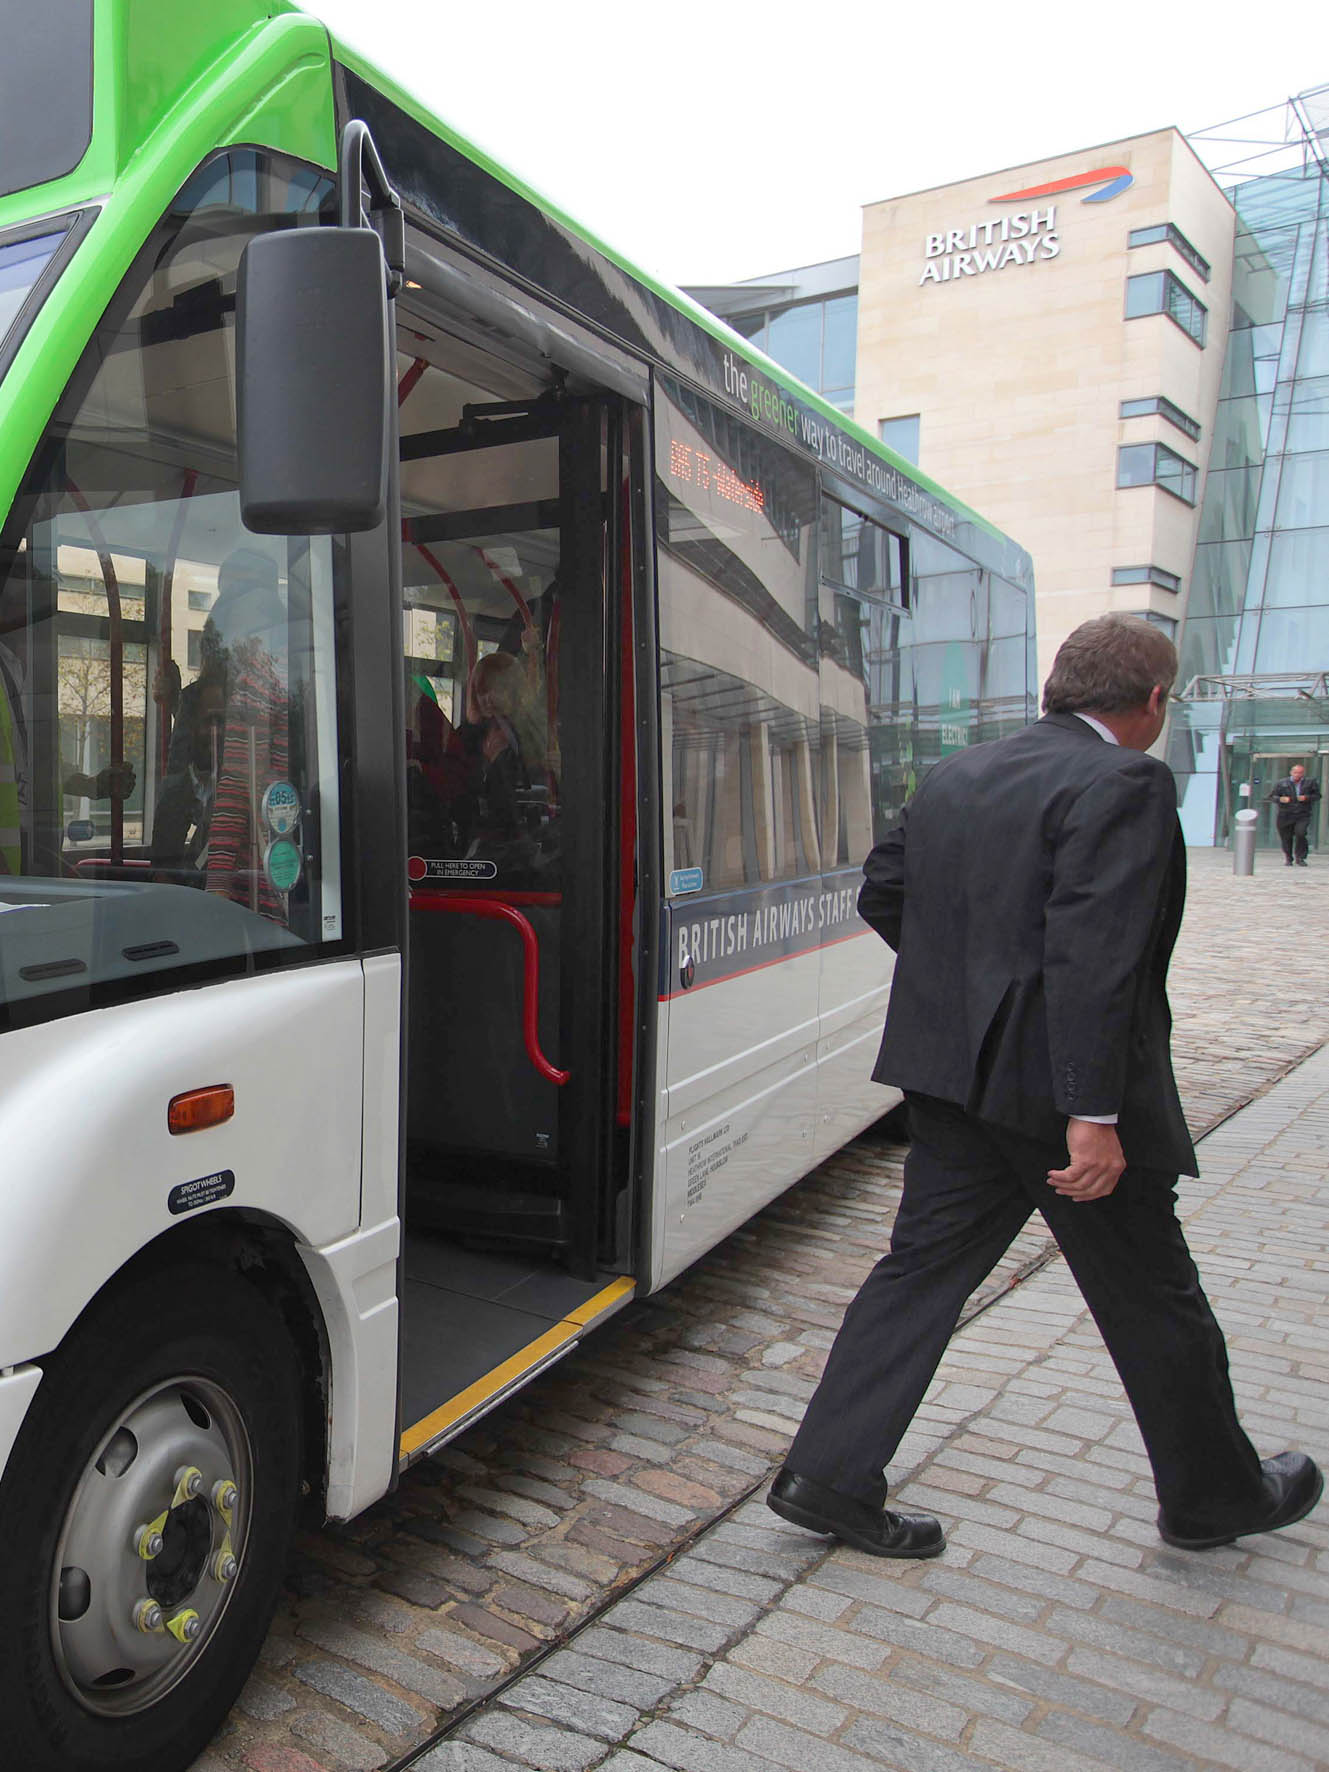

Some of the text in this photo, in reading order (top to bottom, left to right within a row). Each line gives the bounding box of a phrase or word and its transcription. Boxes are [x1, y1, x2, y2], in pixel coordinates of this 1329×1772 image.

[925, 205, 1057, 259] BRITISH
[919, 232, 1061, 287] AIRWAYS
[723, 353, 748, 403] the
[750, 380, 799, 435] greener
[800, 414, 824, 460] way
[825, 426, 837, 461] to
[838, 435, 865, 480] travel
[866, 460, 897, 499] around
[897, 475, 932, 521] Heathrow
[444, 869, 479, 877] EMERGENCY
[678, 913, 748, 969] BRITISH
[753, 897, 815, 947] AIRWAYS
[818, 888, 853, 928] STAFF
[180, 1174, 222, 1195] SPIGOT WHEELS
